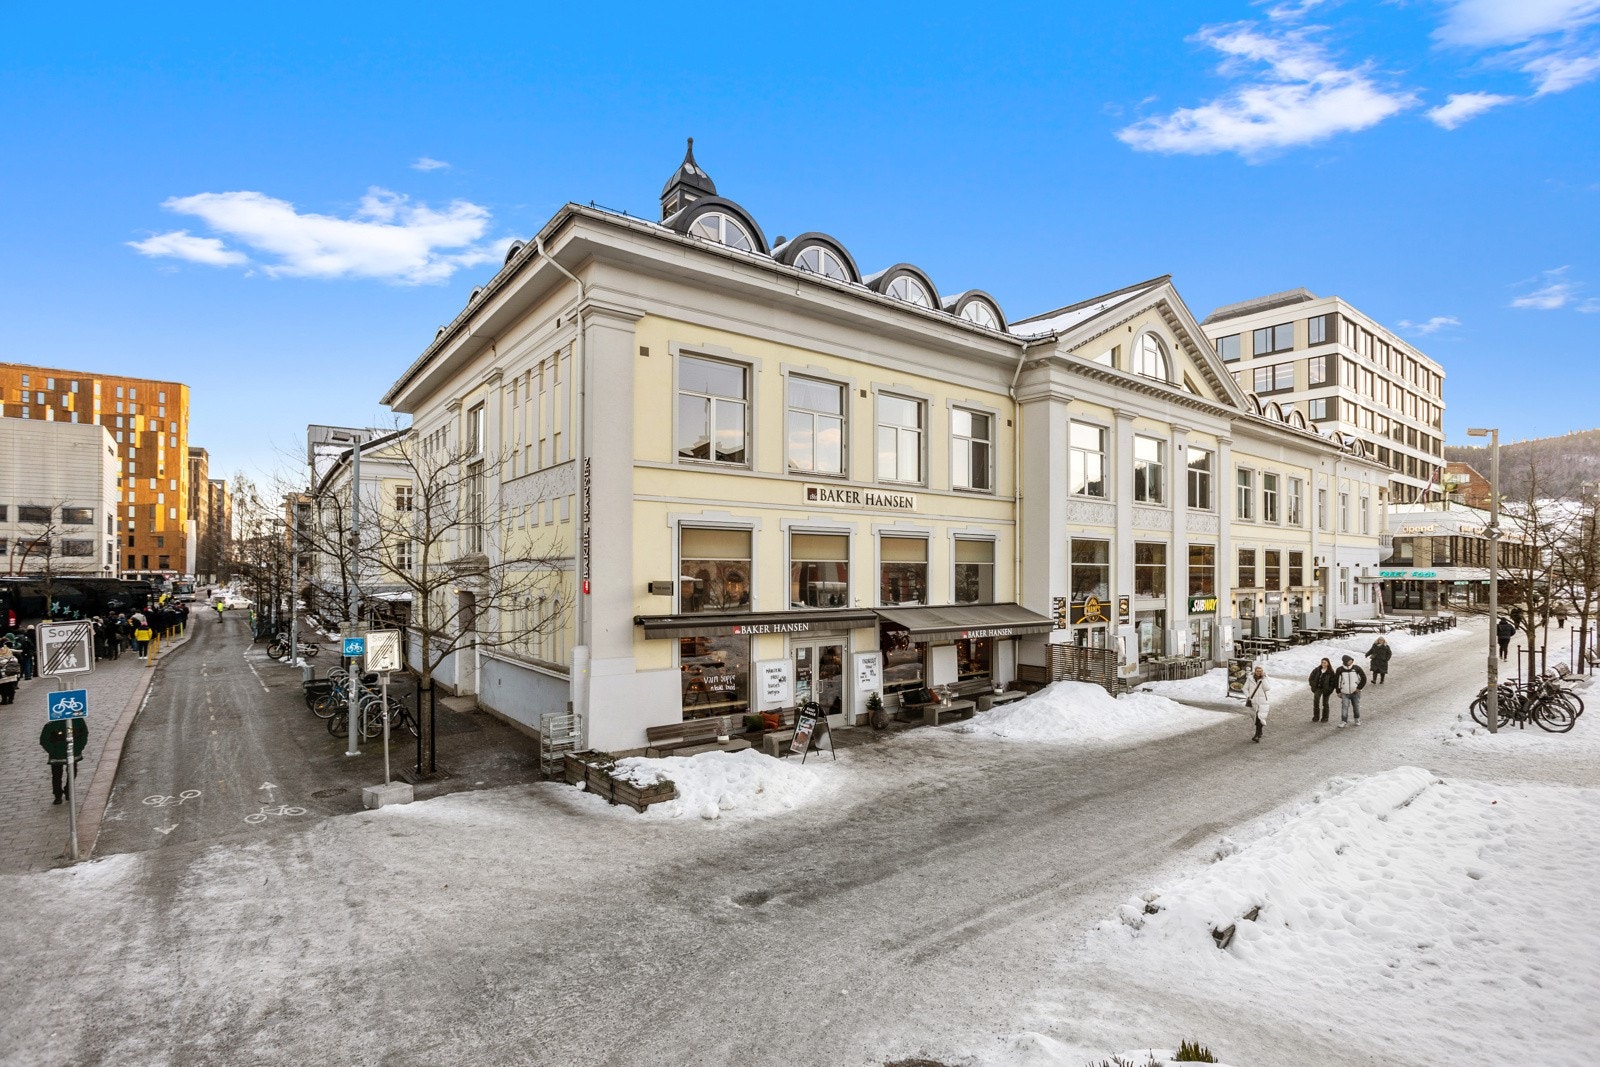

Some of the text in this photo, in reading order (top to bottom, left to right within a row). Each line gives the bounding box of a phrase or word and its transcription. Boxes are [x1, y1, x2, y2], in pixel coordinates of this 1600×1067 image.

[820, 488, 861, 504] BAKER
[865, 493, 914, 509] HANSEN
[1192, 598, 1218, 612] SUBWAY
[741, 624, 771, 635] BAKER
[773, 622, 809, 633] HANSEN
[967, 630, 988, 638] BAKER
[988, 628, 1013, 637] HANSEN
